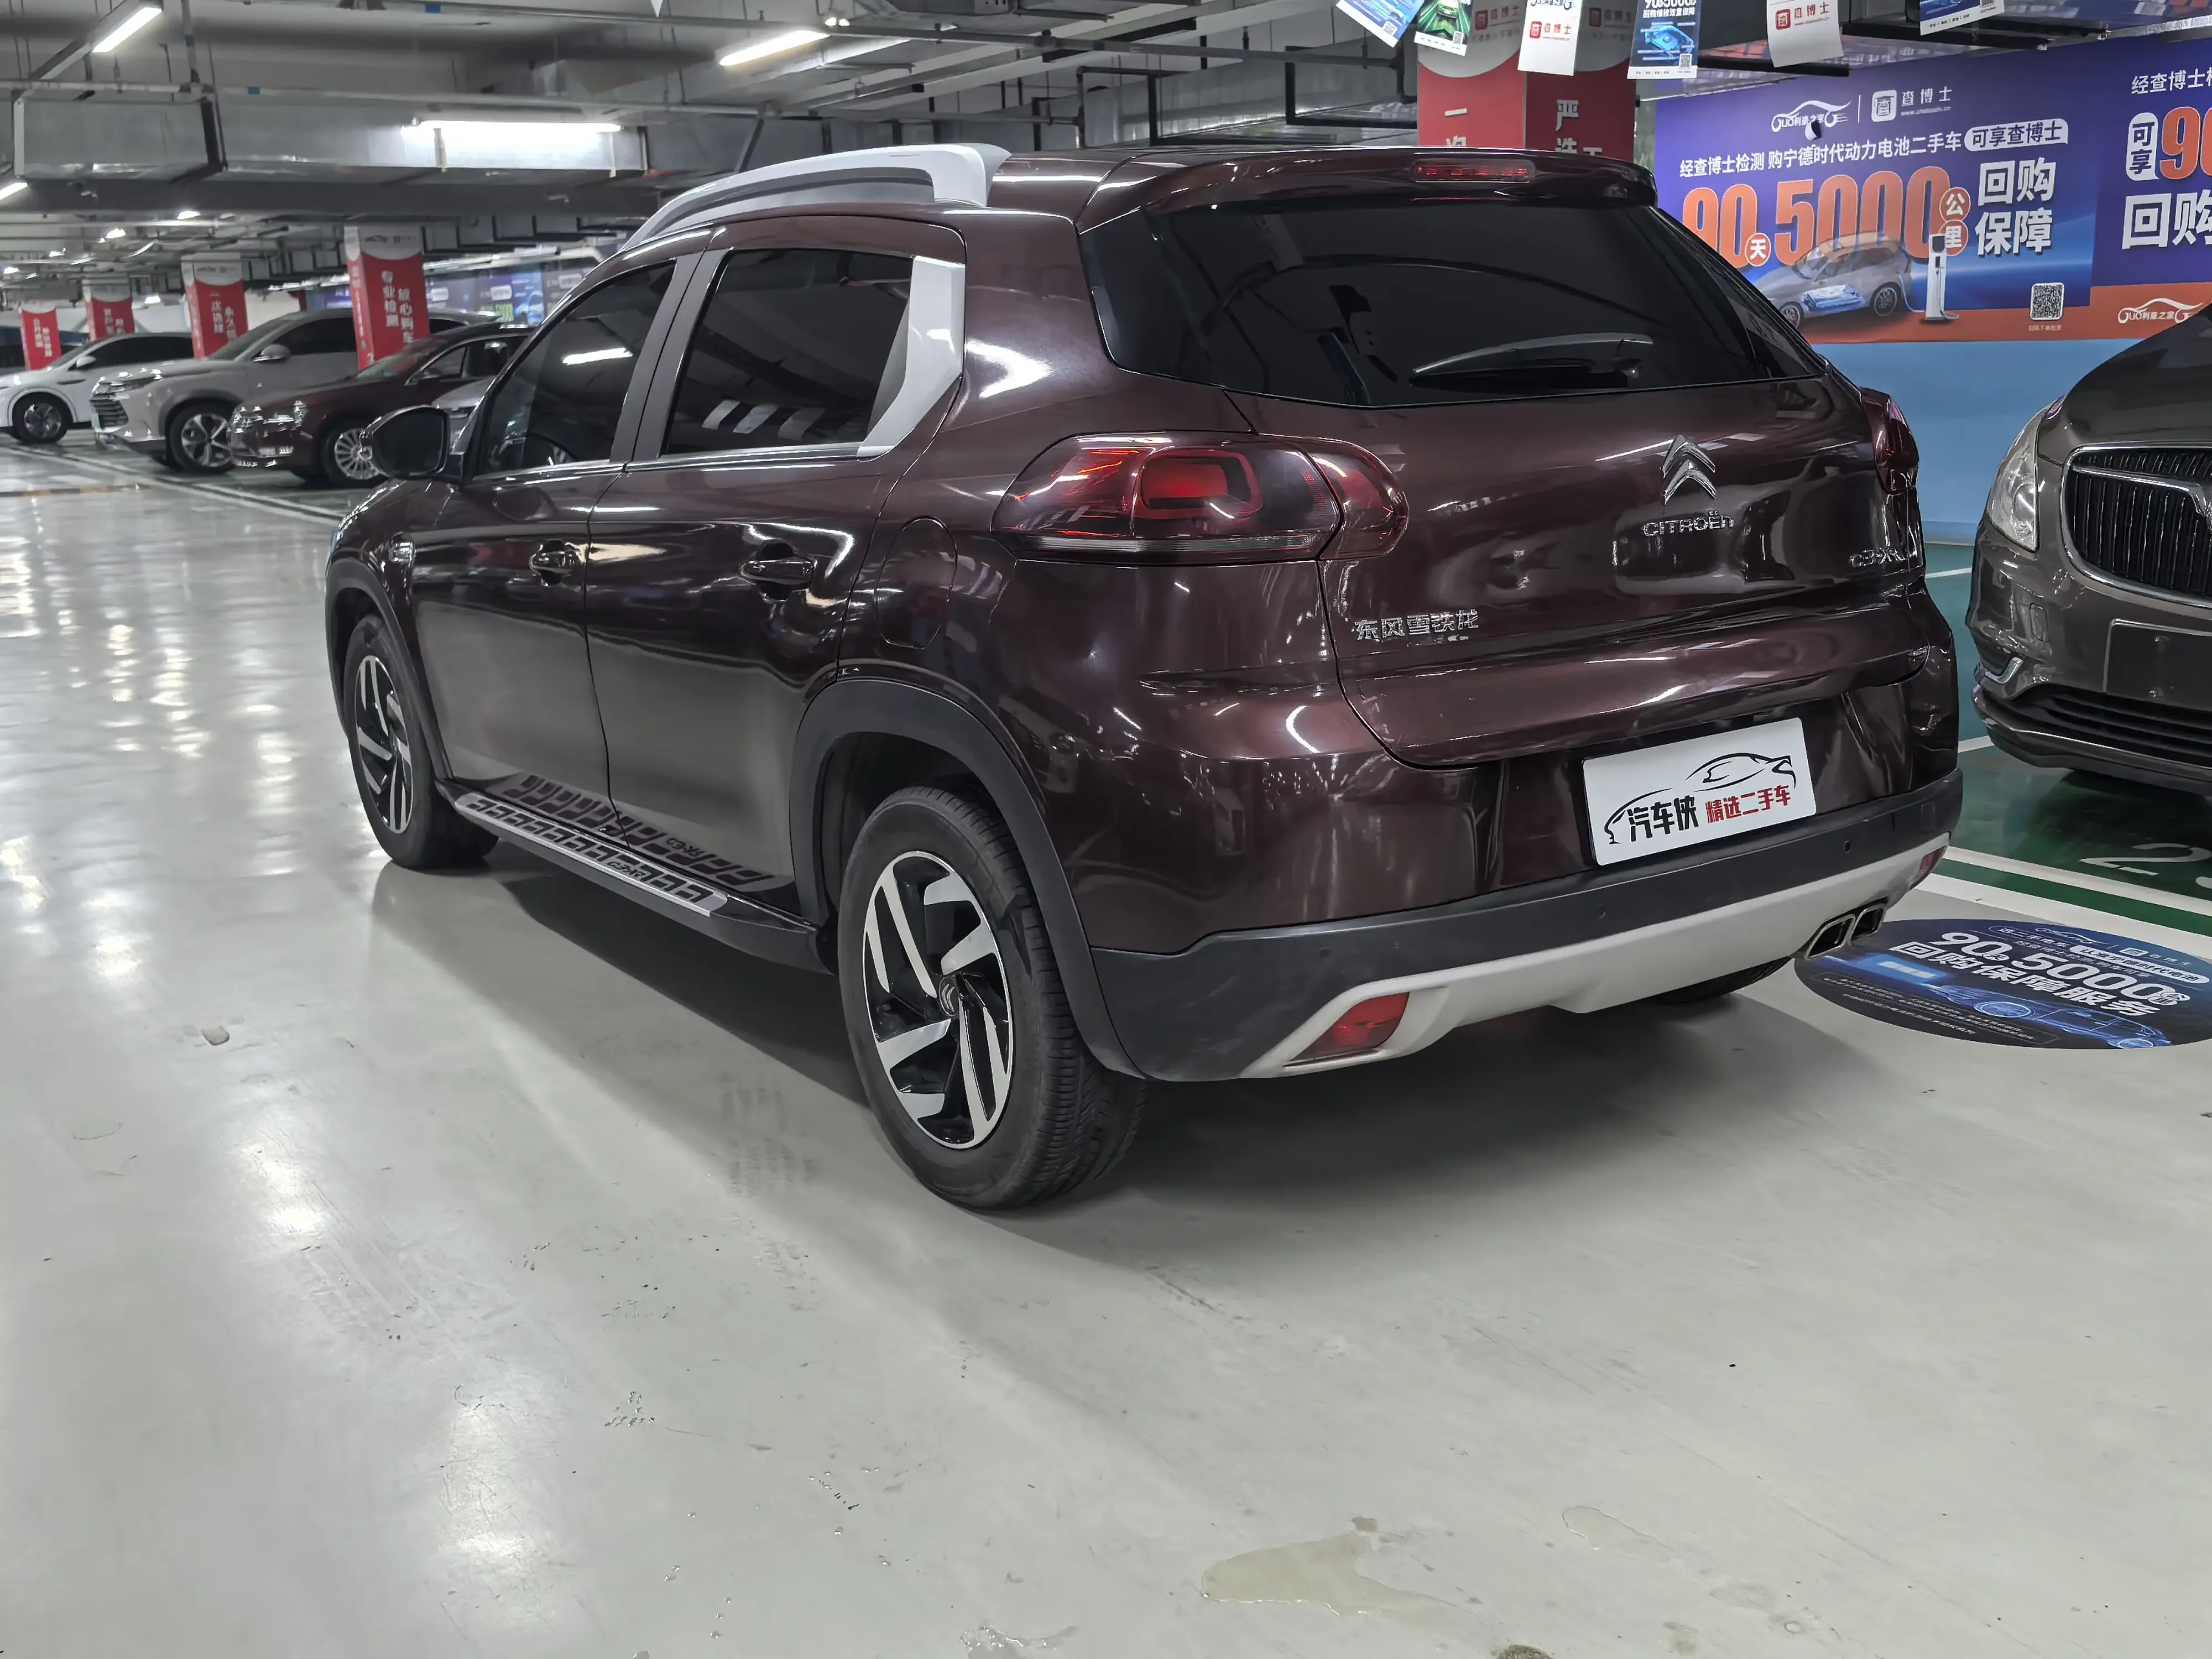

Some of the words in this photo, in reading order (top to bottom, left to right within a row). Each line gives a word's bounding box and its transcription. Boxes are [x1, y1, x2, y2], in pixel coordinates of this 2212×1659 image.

[1901, 86, 1952, 107] 查博士
[1679, 153, 1765, 178] 经查博士检测
[1768, 131, 1962, 169] 购宁德时代动力电池二手车
[1971, 120, 2063, 149] 可享查博士
[2129, 121, 2155, 175] 可享
[1978, 157, 2056, 206] 回购
[1975, 207, 2053, 256] 保障
[2122, 189, 2212, 249] 回购
[1641, 509, 1734, 536] CITROËN
[1354, 609, 1478, 641] 东风雪铁龙
[1627, 795, 1699, 842] 汽车侠
[1705, 785, 1791, 823] 精选二手车
[1888, 941, 2160, 1017] 回购保障服务
